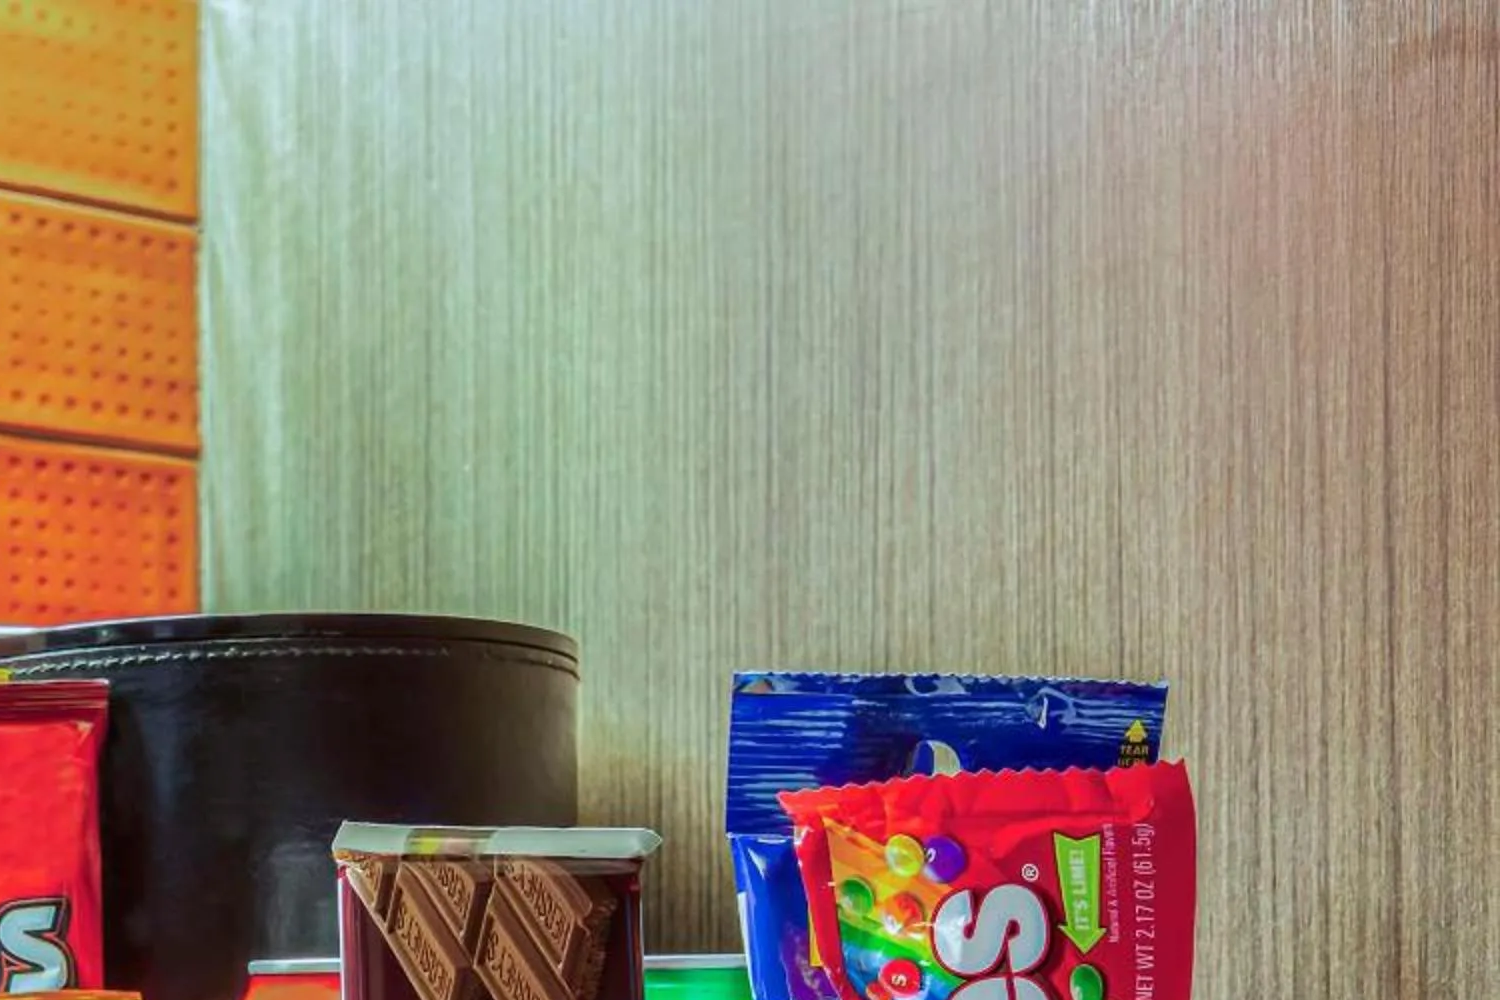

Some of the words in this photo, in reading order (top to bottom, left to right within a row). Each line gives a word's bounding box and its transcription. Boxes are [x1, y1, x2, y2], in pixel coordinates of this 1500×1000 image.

[1131, 823, 1158, 876] (61.5g)
[1068, 849, 1087, 896] LIME!
[1073, 900, 1090, 931] IT'S
[1135, 905, 1155, 939] 2.17
[1134, 943, 1155, 971] WT
